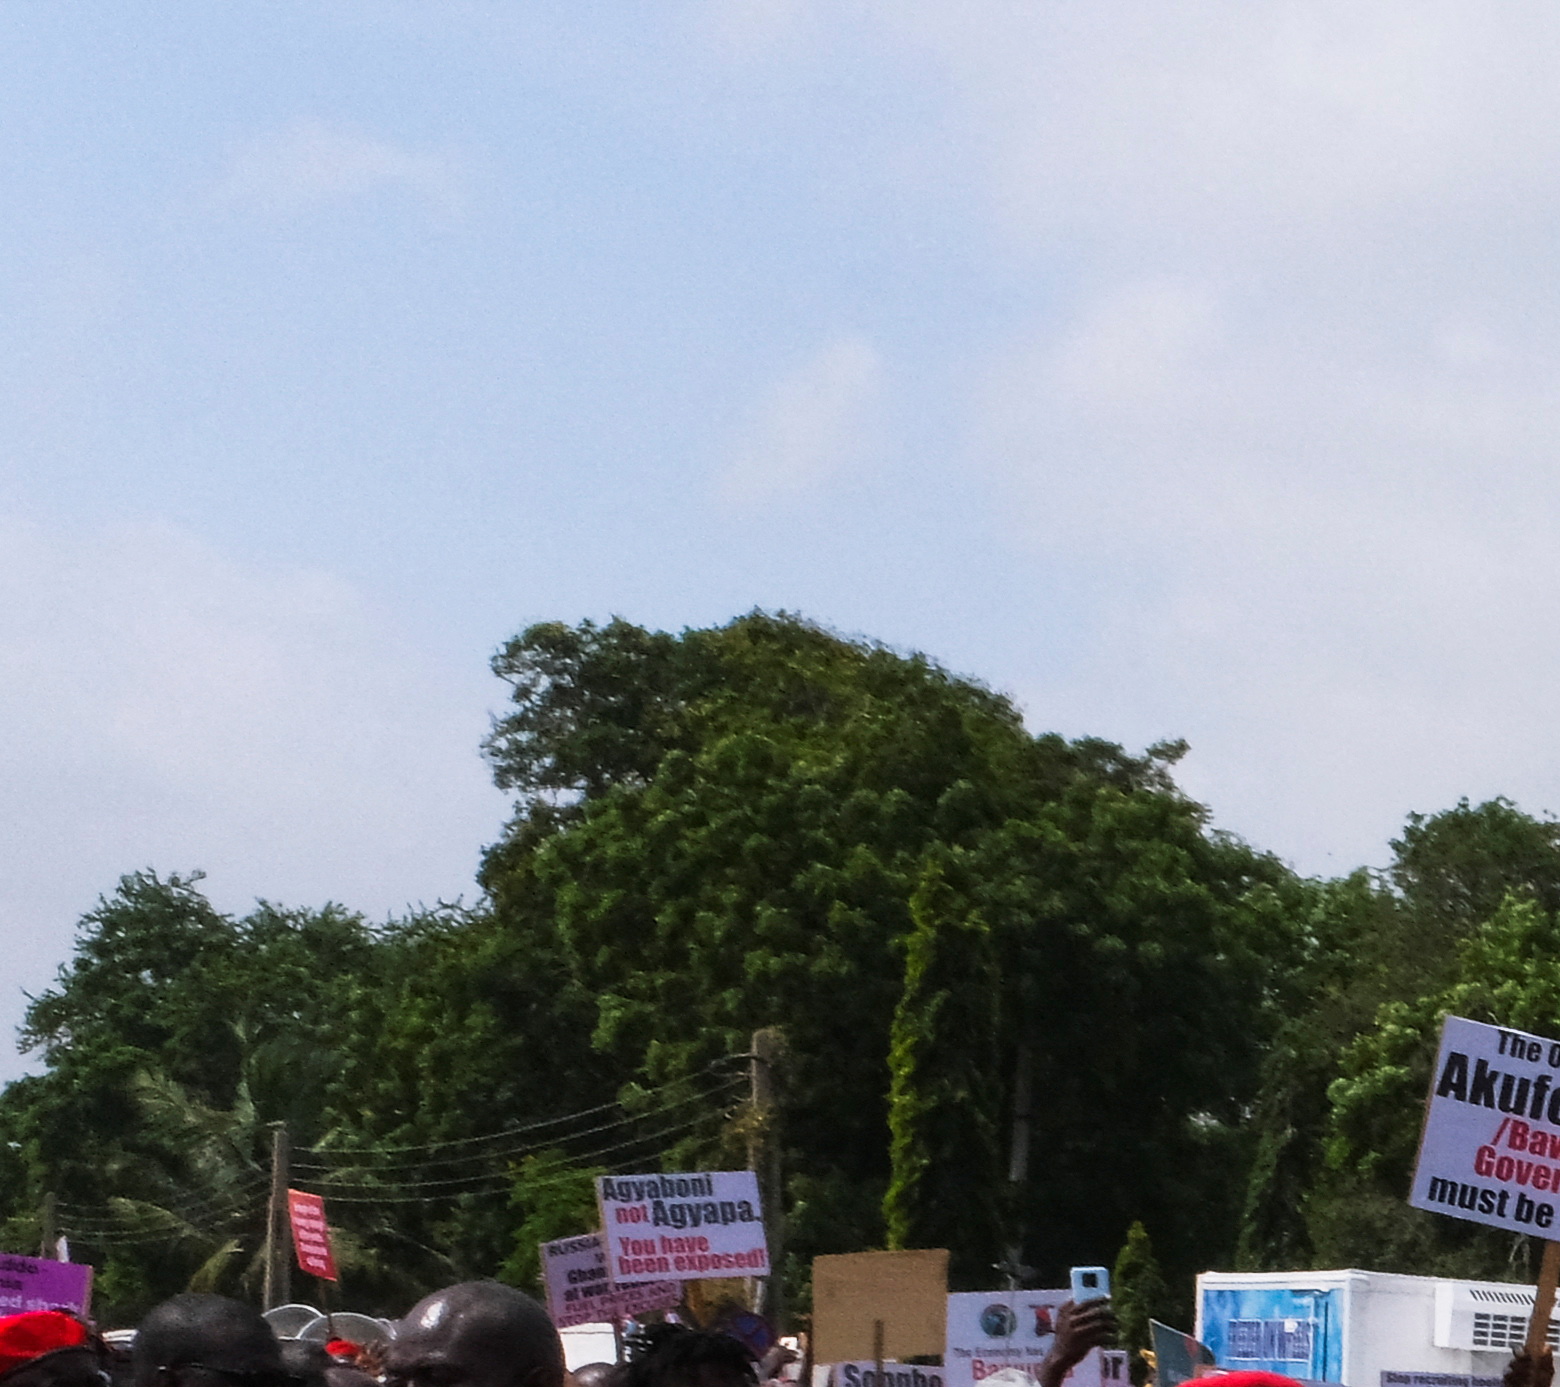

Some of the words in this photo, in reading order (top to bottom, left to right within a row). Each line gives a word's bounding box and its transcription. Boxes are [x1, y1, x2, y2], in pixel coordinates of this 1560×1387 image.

[1498, 1030, 1542, 1062] The
[602, 1174, 713, 1202] Agyaboni
[616, 1204, 650, 1223] not
[1429, 1176, 1510, 1218] must
[1516, 1192, 1555, 1229] be
[619, 1236, 655, 1256] You
[660, 1235, 709, 1254] have
[619, 1256, 669, 1275] been
[674, 1249, 766, 1272] exposed!
